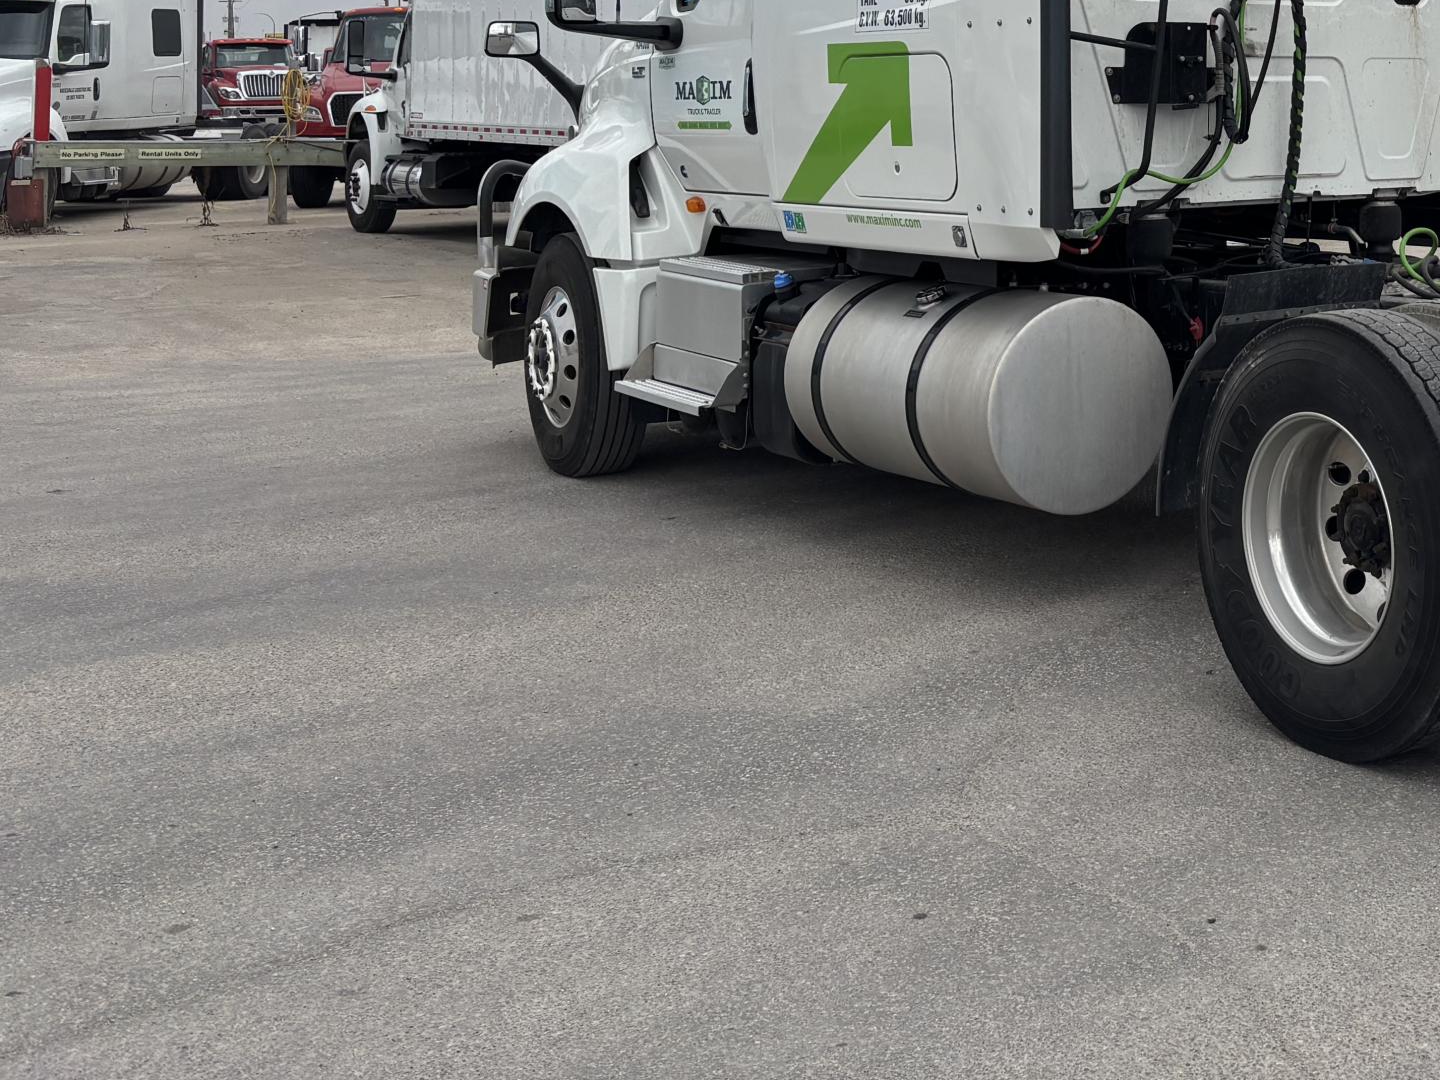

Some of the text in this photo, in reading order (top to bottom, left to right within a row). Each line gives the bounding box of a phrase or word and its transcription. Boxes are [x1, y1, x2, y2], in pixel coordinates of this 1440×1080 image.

[859, 8, 926, 27] G.V.W. 63,500 kg.
[675, 75, 732, 106] MAXIM
[73, 151, 99, 159] Parking
[183, 150, 199, 158] Only
[846, 213, 922, 228] www.maximinc.com
